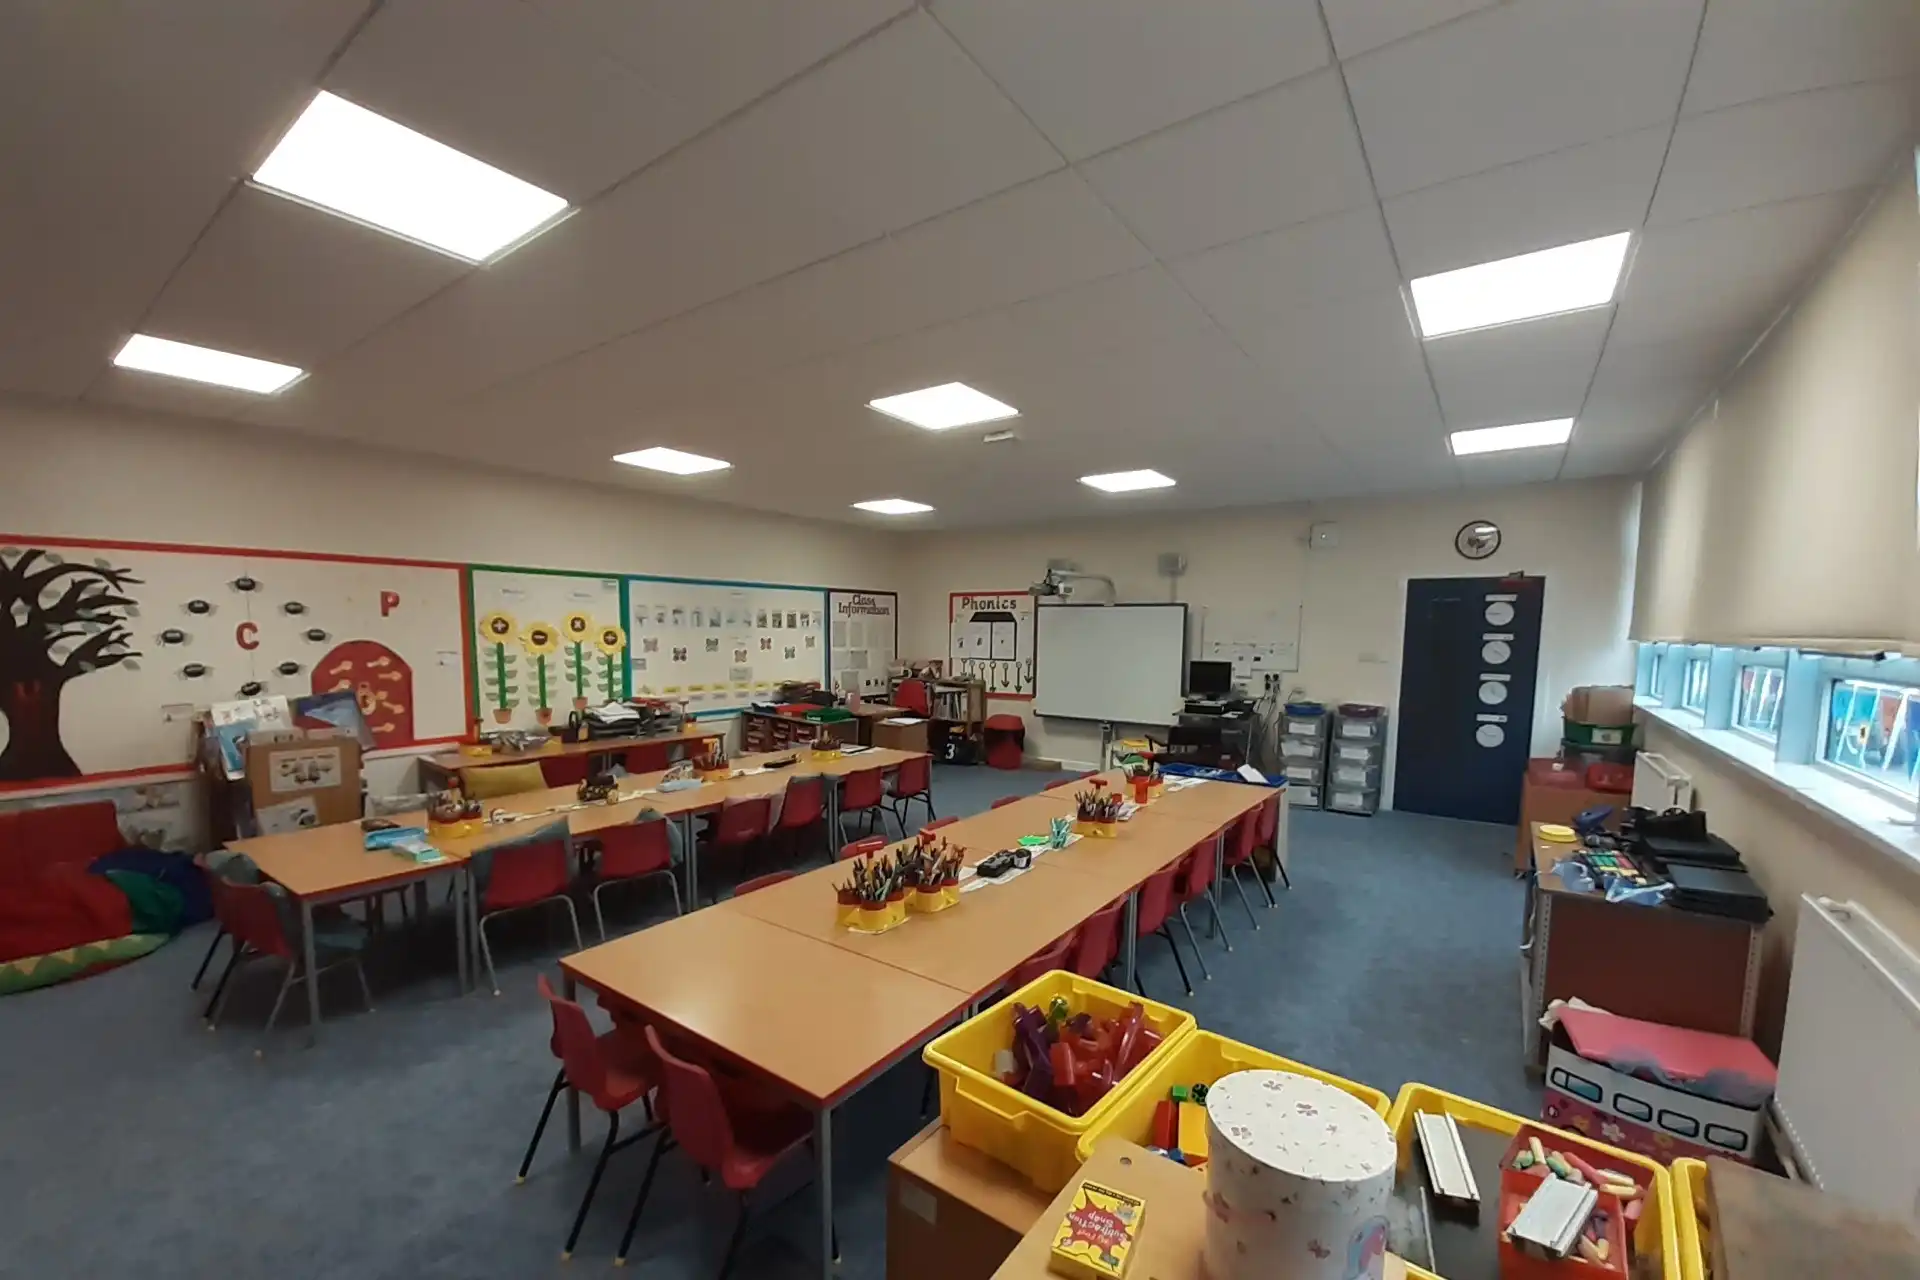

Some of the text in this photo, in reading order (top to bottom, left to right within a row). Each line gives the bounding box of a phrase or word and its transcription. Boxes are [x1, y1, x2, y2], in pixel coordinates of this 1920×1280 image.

[380, 591, 400, 617] P
[852, 594, 877, 606] Class
[961, 596, 1017, 610] Phonics
[838, 601, 890, 618] Information
[236, 622, 259, 650] C
[945, 743, 956, 760] 3
[1088, 1210, 1115, 1228] Snap
